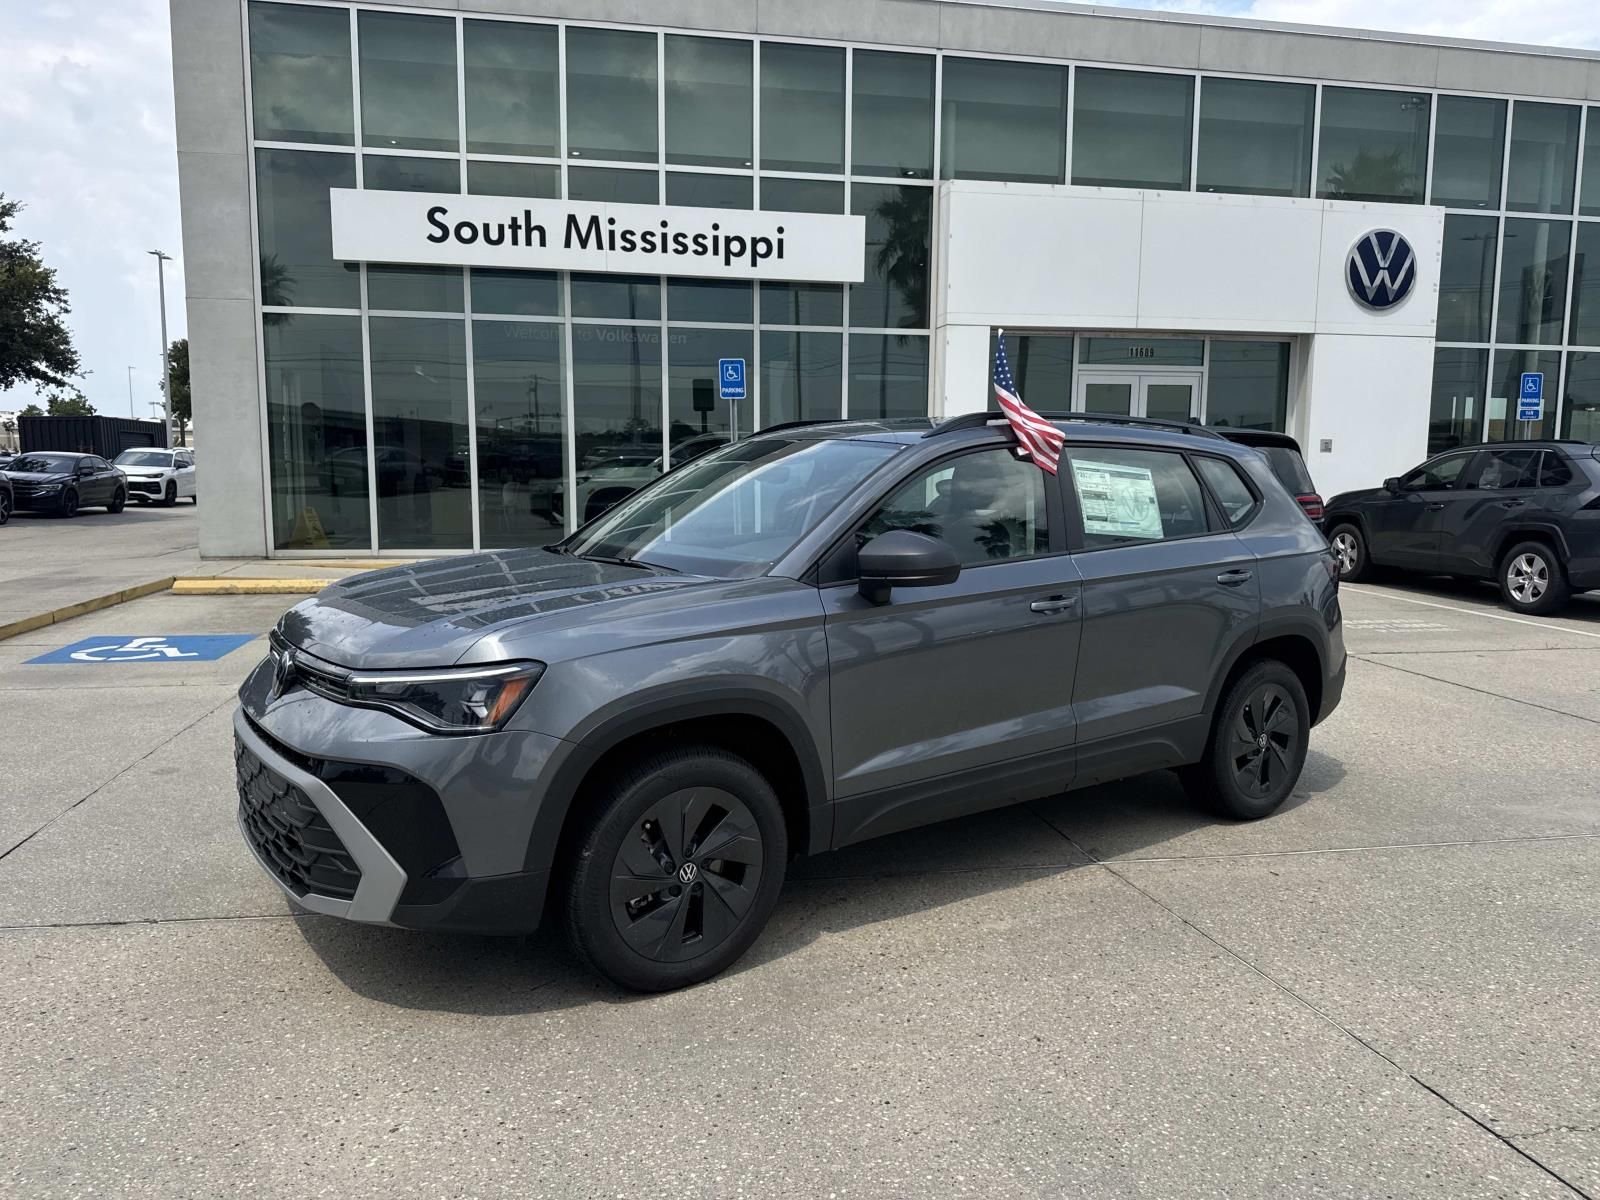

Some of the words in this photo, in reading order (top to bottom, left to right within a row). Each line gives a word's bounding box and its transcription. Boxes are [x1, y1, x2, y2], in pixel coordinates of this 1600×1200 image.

[426, 206, 548, 248] South
[563, 213, 785, 268] Mississippi
[1345, 228, 1416, 310] VW
[596, 329, 688, 345] Volkswaen
[679, 862, 697, 883] VW
